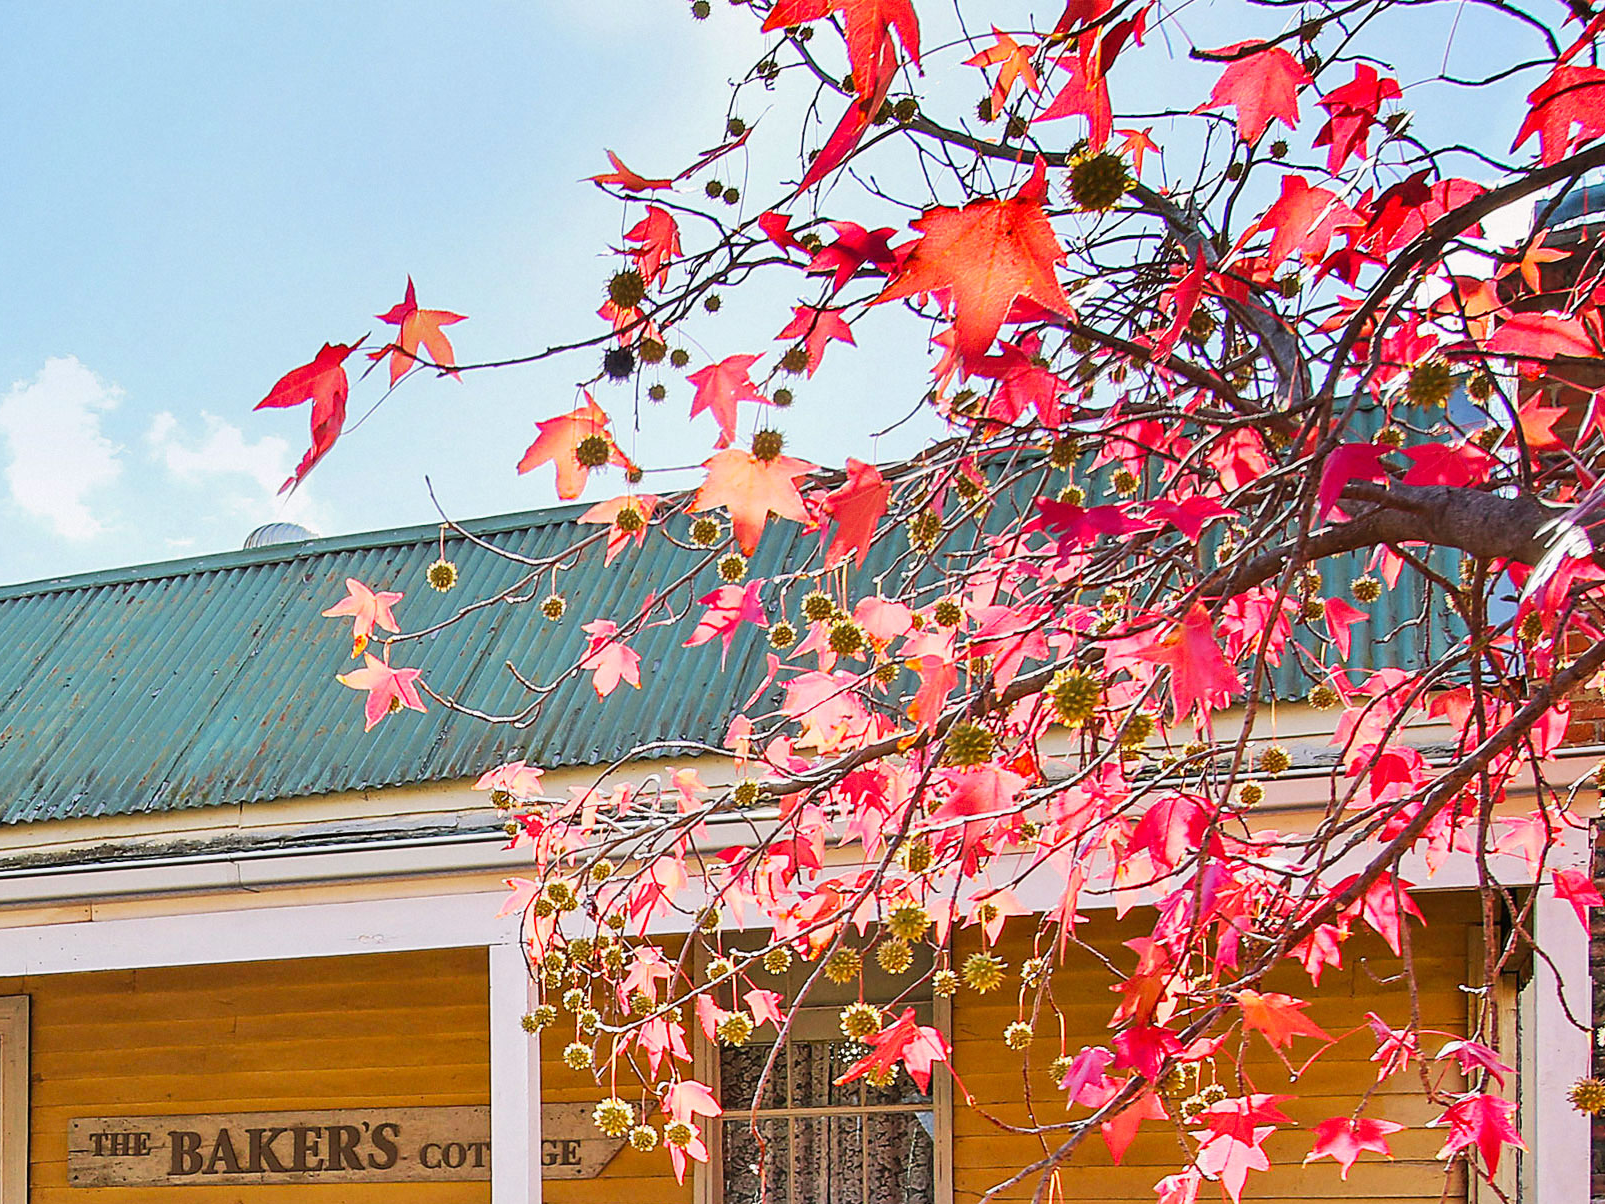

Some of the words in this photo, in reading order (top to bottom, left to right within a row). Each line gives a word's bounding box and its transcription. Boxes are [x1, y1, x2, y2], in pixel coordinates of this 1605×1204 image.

[89, 1132, 151, 1156] THE
[167, 1122, 399, 1175] BAKER'S
[419, 1140, 582, 1169] COTGE
